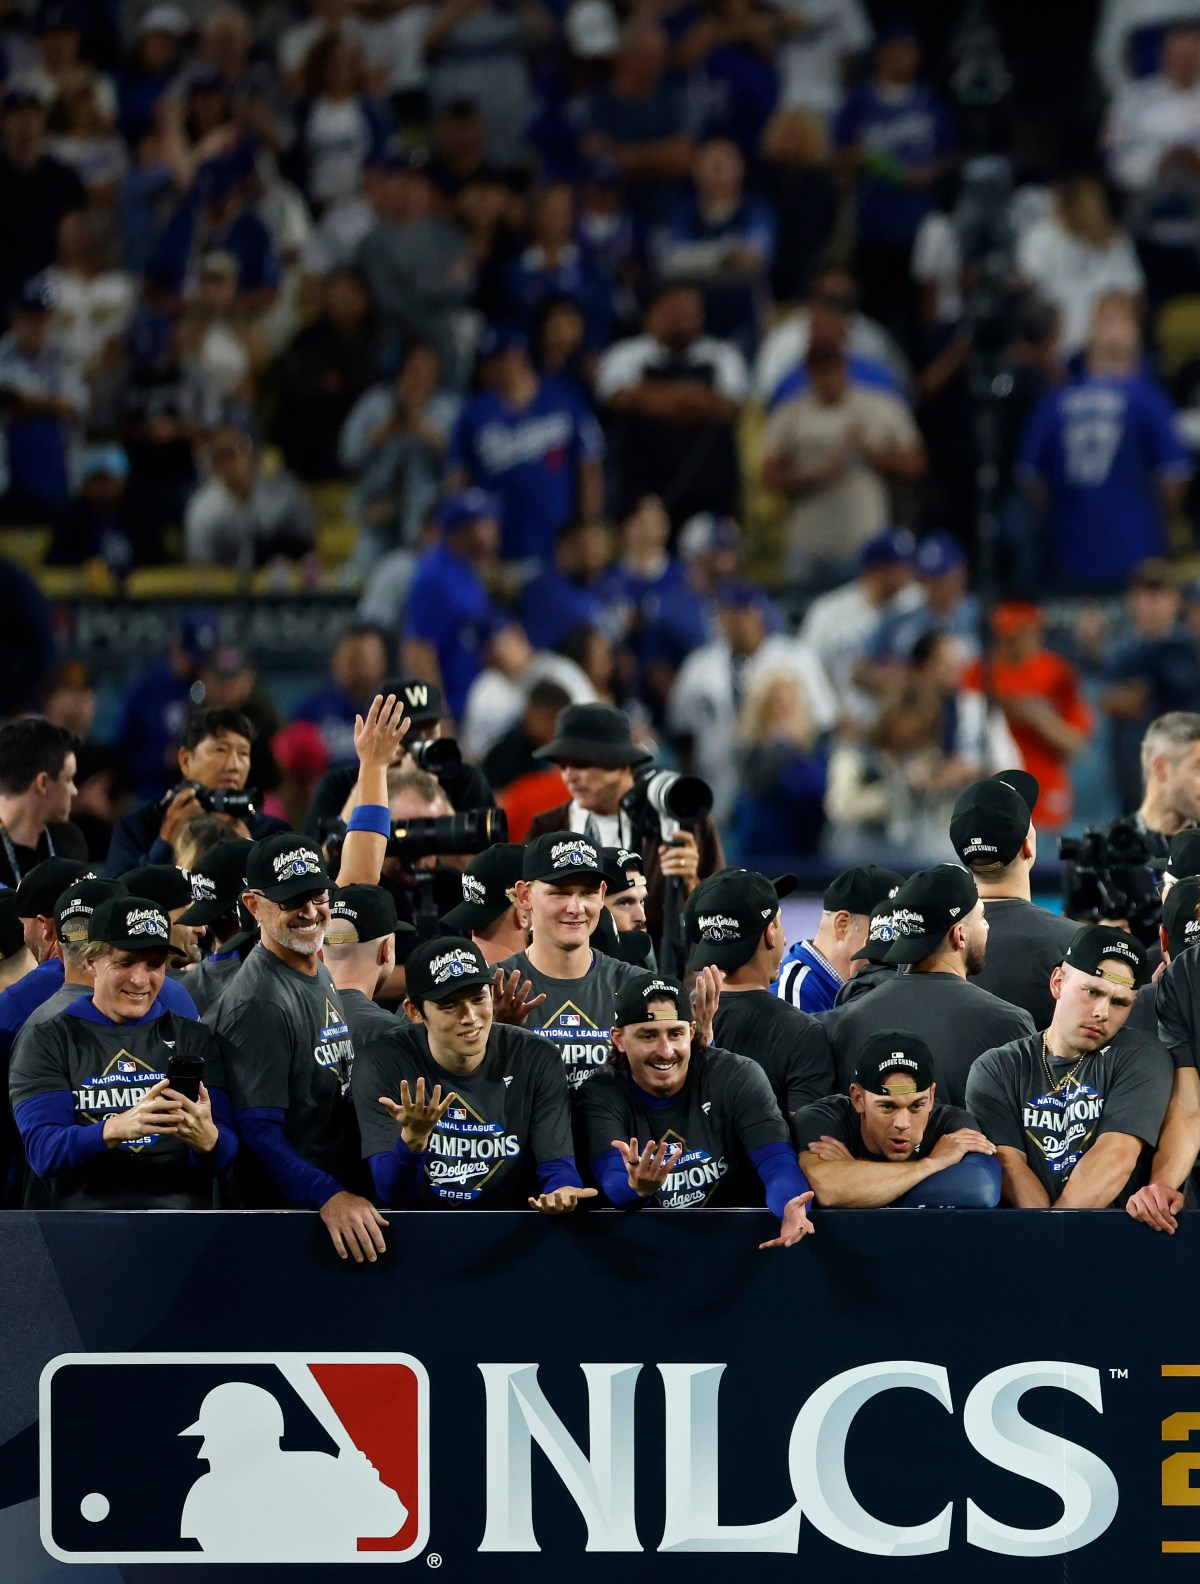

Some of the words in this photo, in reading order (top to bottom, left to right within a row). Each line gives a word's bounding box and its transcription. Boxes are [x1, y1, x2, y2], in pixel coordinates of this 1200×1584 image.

[405, 685, 428, 707] W
[551, 841, 577, 860] World
[577, 840, 598, 859] Series
[273, 851, 299, 873] World
[299, 847, 320, 864] Series
[126, 908, 152, 926] World
[716, 914, 739, 928] Series
[430, 952, 455, 976] World
[454, 948, 477, 965] Series
[1102, 947, 1122, 957] LEAGUE
[1122, 948, 1140, 965] CHAMPS
[642, 985, 659, 997] LEAGUE
[533, 1028, 574, 1039] NATIONAL
[576, 1029, 609, 1039] LEAGUE
[557, 1044, 609, 1065] MPIO
[878, 1058, 898, 1072] LEAGUE
[898, 1058, 919, 1071] CHAMPS
[91, 1073, 132, 1085] NATIONAL
[133, 1072, 167, 1083] LEAGUE
[72, 1086, 151, 1111] HAMP
[1037, 1096, 1066, 1108] NATION
[462, 1123, 496, 1132] LEAGUE
[428, 1133, 520, 1159] AMPIONS
[429, 1160, 490, 1185] Dodgers
[439, 1189, 473, 1201] 2025
[477, 1358, 1119, 1558] NLCS
